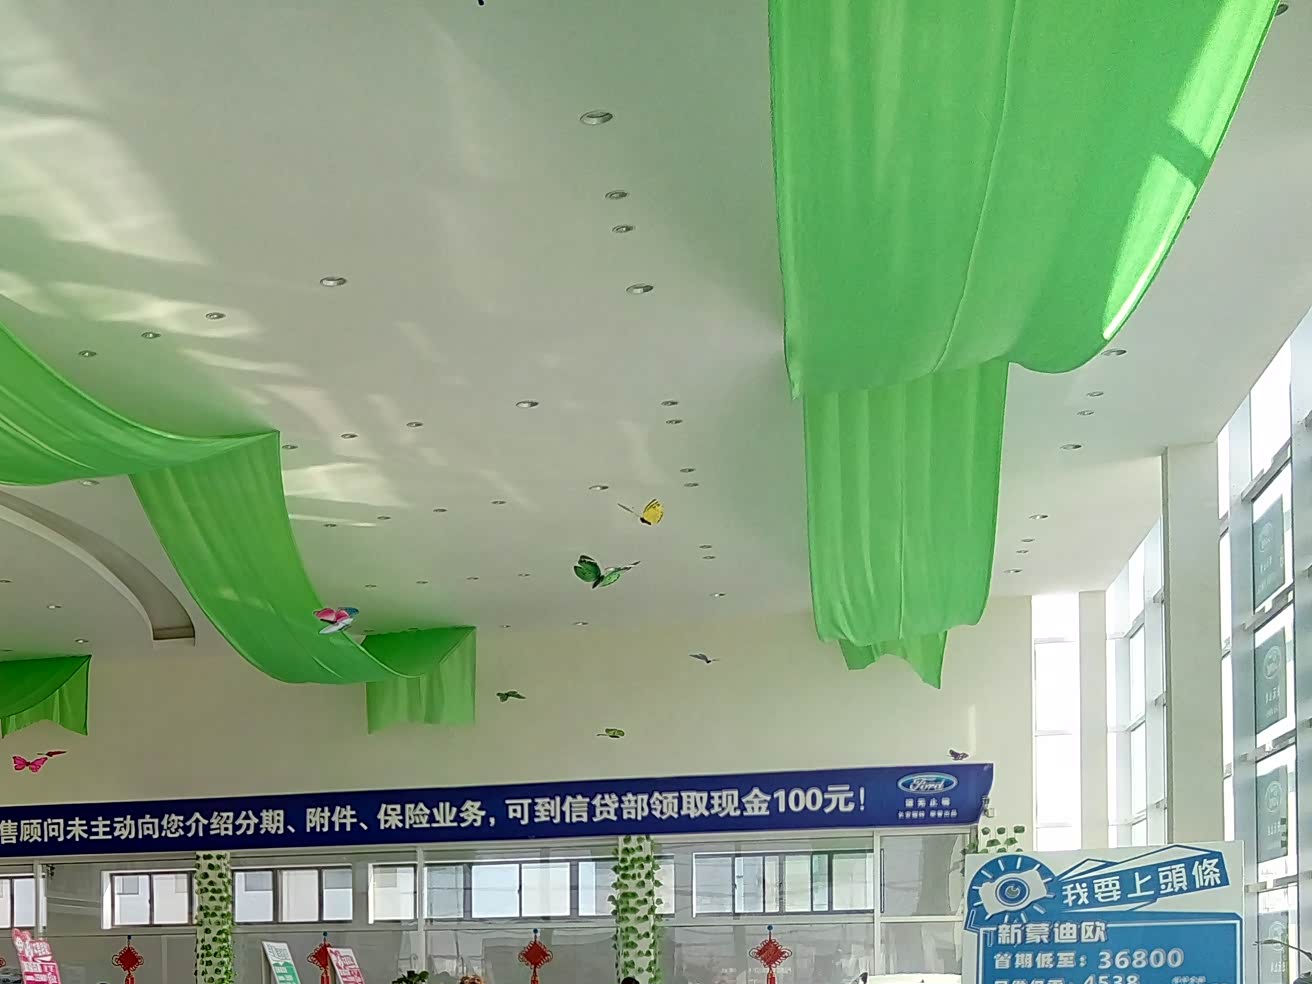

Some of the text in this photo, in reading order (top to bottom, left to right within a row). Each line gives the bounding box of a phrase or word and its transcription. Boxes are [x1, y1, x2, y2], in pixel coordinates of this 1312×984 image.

[910, 777, 945, 791] Ford
[1062, 858, 1222, 907] 我要上頭條
[997, 921, 1108, 945] 新蒙迪欧
